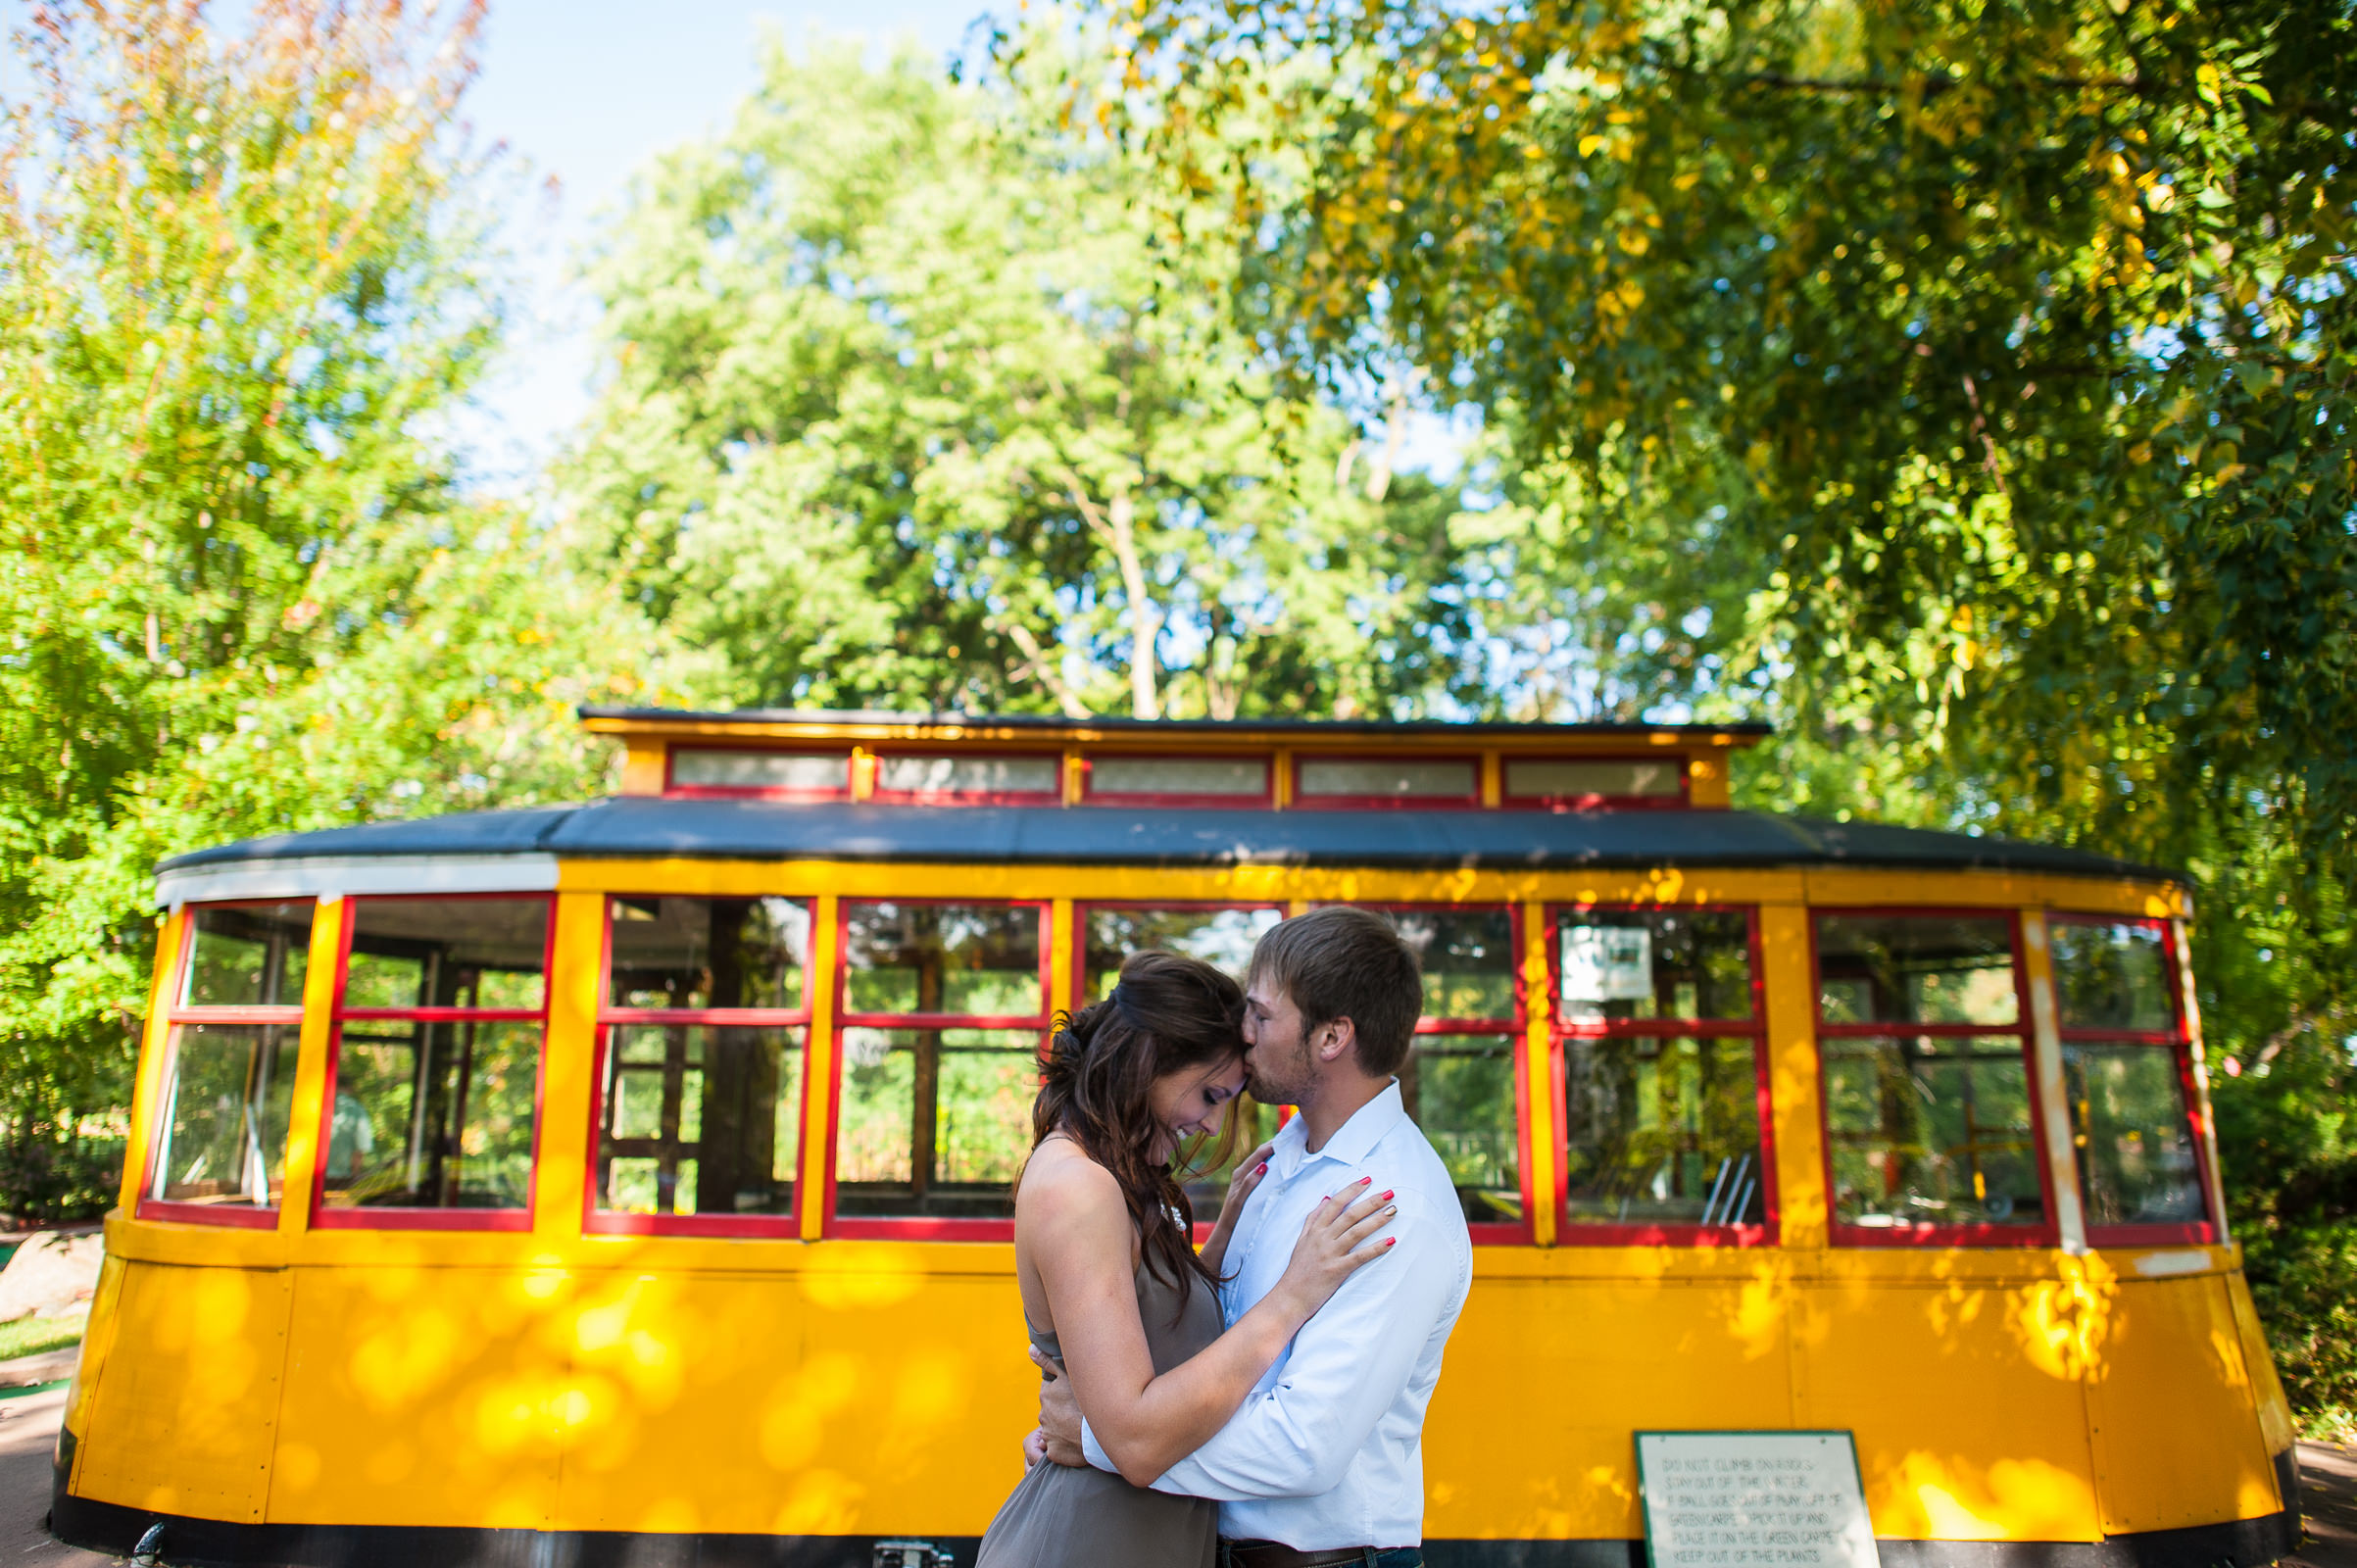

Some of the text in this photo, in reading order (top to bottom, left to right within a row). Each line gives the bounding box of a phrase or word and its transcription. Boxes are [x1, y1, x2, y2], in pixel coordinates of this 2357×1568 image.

[1664, 1476, 1693, 1490] STAY
[1694, 1476, 1714, 1490] OUT
[1717, 1476, 1732, 1490] OF
[1739, 1476, 1761, 1490] THE
[1678, 1494, 1707, 1507] BALL
[1790, 1512, 1804, 1527] UP
[1806, 1512, 1830, 1527] AND
[1672, 1531, 1705, 1545] PLACE
[1719, 1531, 1737, 1545] ON
[1738, 1531, 1759, 1545] THE
[1762, 1531, 1798, 1545] GREEN
[1673, 1549, 1704, 1563] KEEP
[1706, 1549, 1728, 1563] OUT
[1733, 1549, 1749, 1563] OF
[1750, 1549, 1775, 1563] THE
